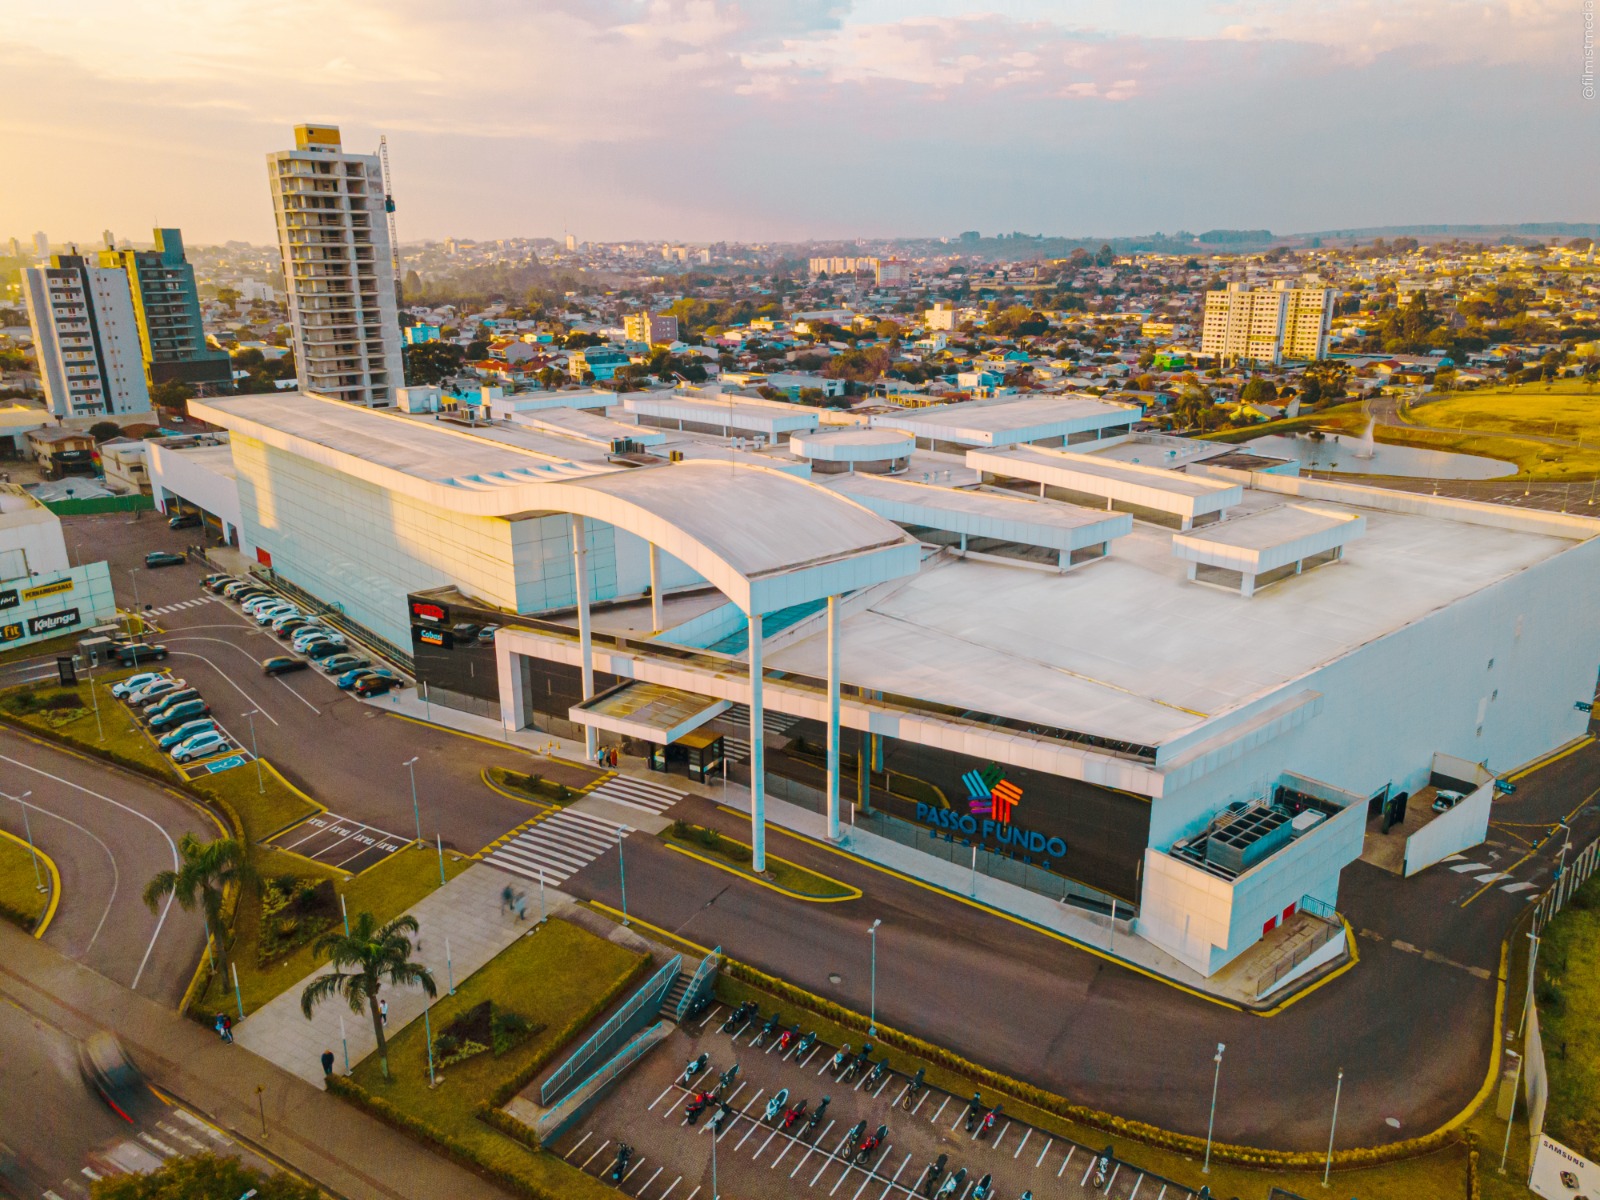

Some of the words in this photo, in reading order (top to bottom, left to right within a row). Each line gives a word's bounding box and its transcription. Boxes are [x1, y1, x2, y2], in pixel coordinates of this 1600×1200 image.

[25, 583, 72, 598] PERNAMBUCANAS
[421, 629, 443, 641] Cobasi
[916, 802, 978, 835] PASSO
[982, 819, 1068, 858] FUNDO
[1543, 1140, 1585, 1169] SAMSUNG
